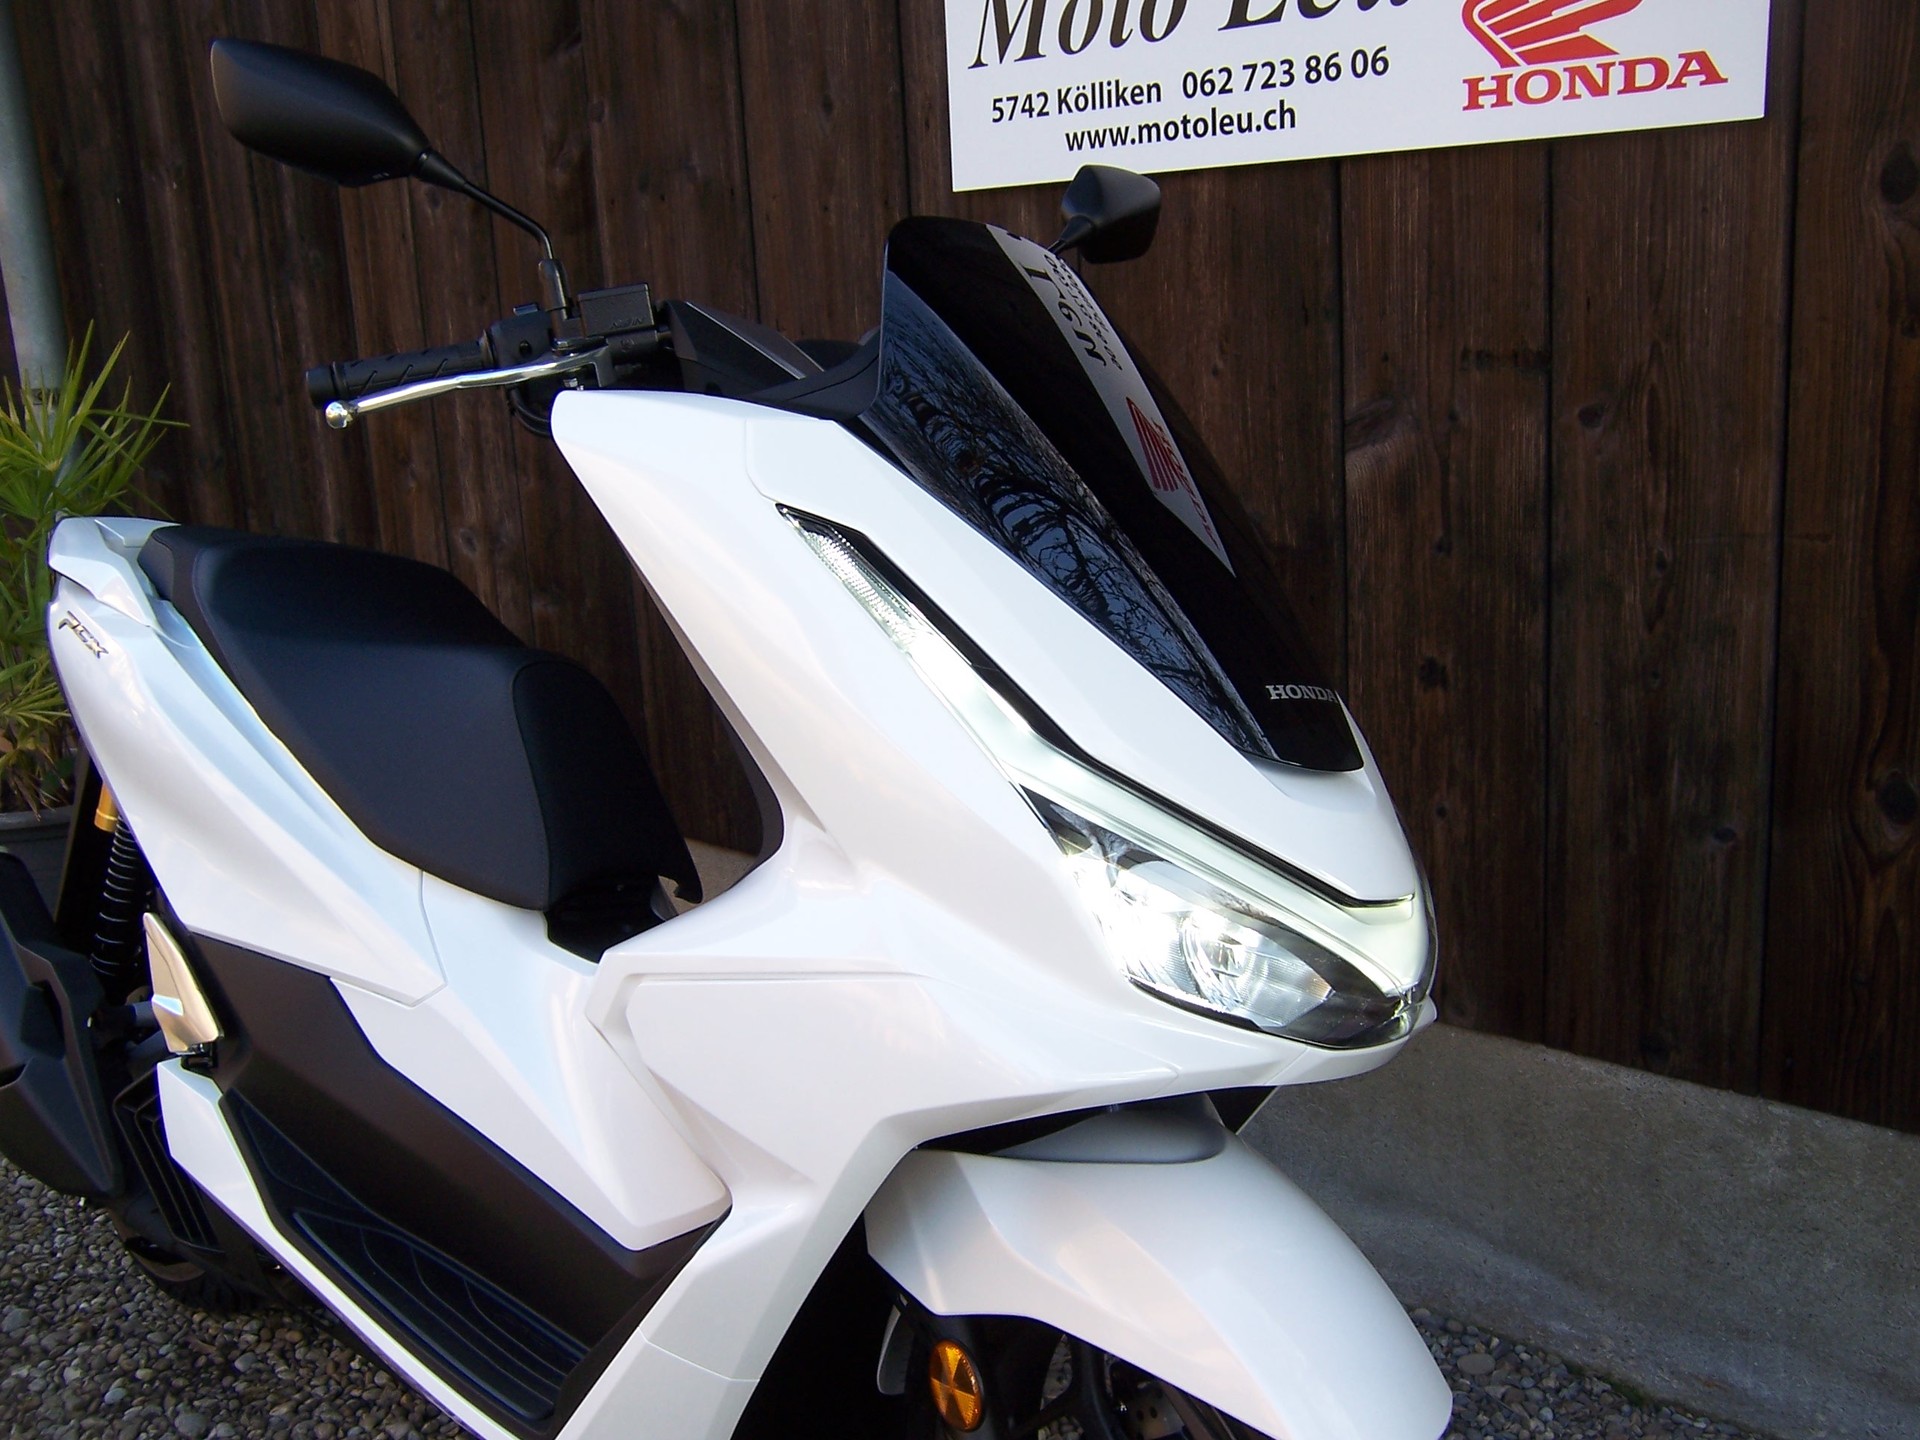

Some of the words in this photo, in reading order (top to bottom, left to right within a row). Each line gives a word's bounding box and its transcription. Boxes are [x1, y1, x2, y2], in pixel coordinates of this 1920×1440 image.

[992, 92, 1050, 122] 5742
[1057, 80, 1162, 115] Kölliken
[1182, 67, 1233, 98] 062
[1242, 58, 1295, 92] 723
[1304, 52, 1342, 84] 86
[1350, 46, 1389, 78] 06
[1462, 50, 1728, 111] HONDA
[1065, 99, 1296, 151] www.motoleu.ch
[1265, 684, 1338, 703] HONDA
